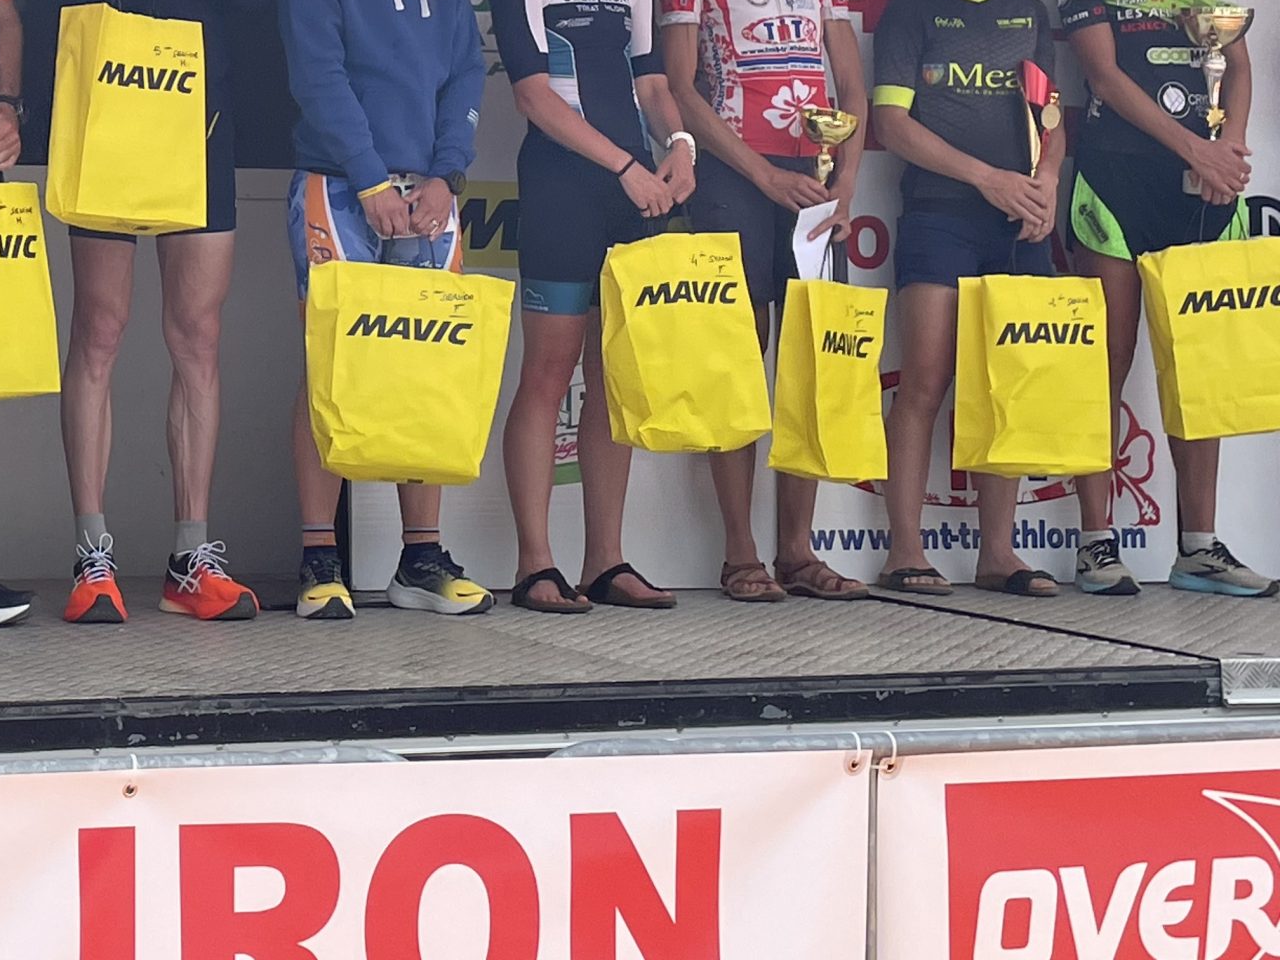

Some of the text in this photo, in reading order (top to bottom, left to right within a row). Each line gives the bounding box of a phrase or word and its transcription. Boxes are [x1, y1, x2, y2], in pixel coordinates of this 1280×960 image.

[1117, 8, 1144, 21] LES
[97, 60, 197, 94] MAVIC
[947, 62, 1019, 88] Mea
[634, 280, 739, 307] MAVIC
[346, 313, 474, 345] MAVIC
[996, 322, 1095, 346] MAVIC
[822, 330, 875, 358] MAVIC
[77, 808, 722, 960] IRON
